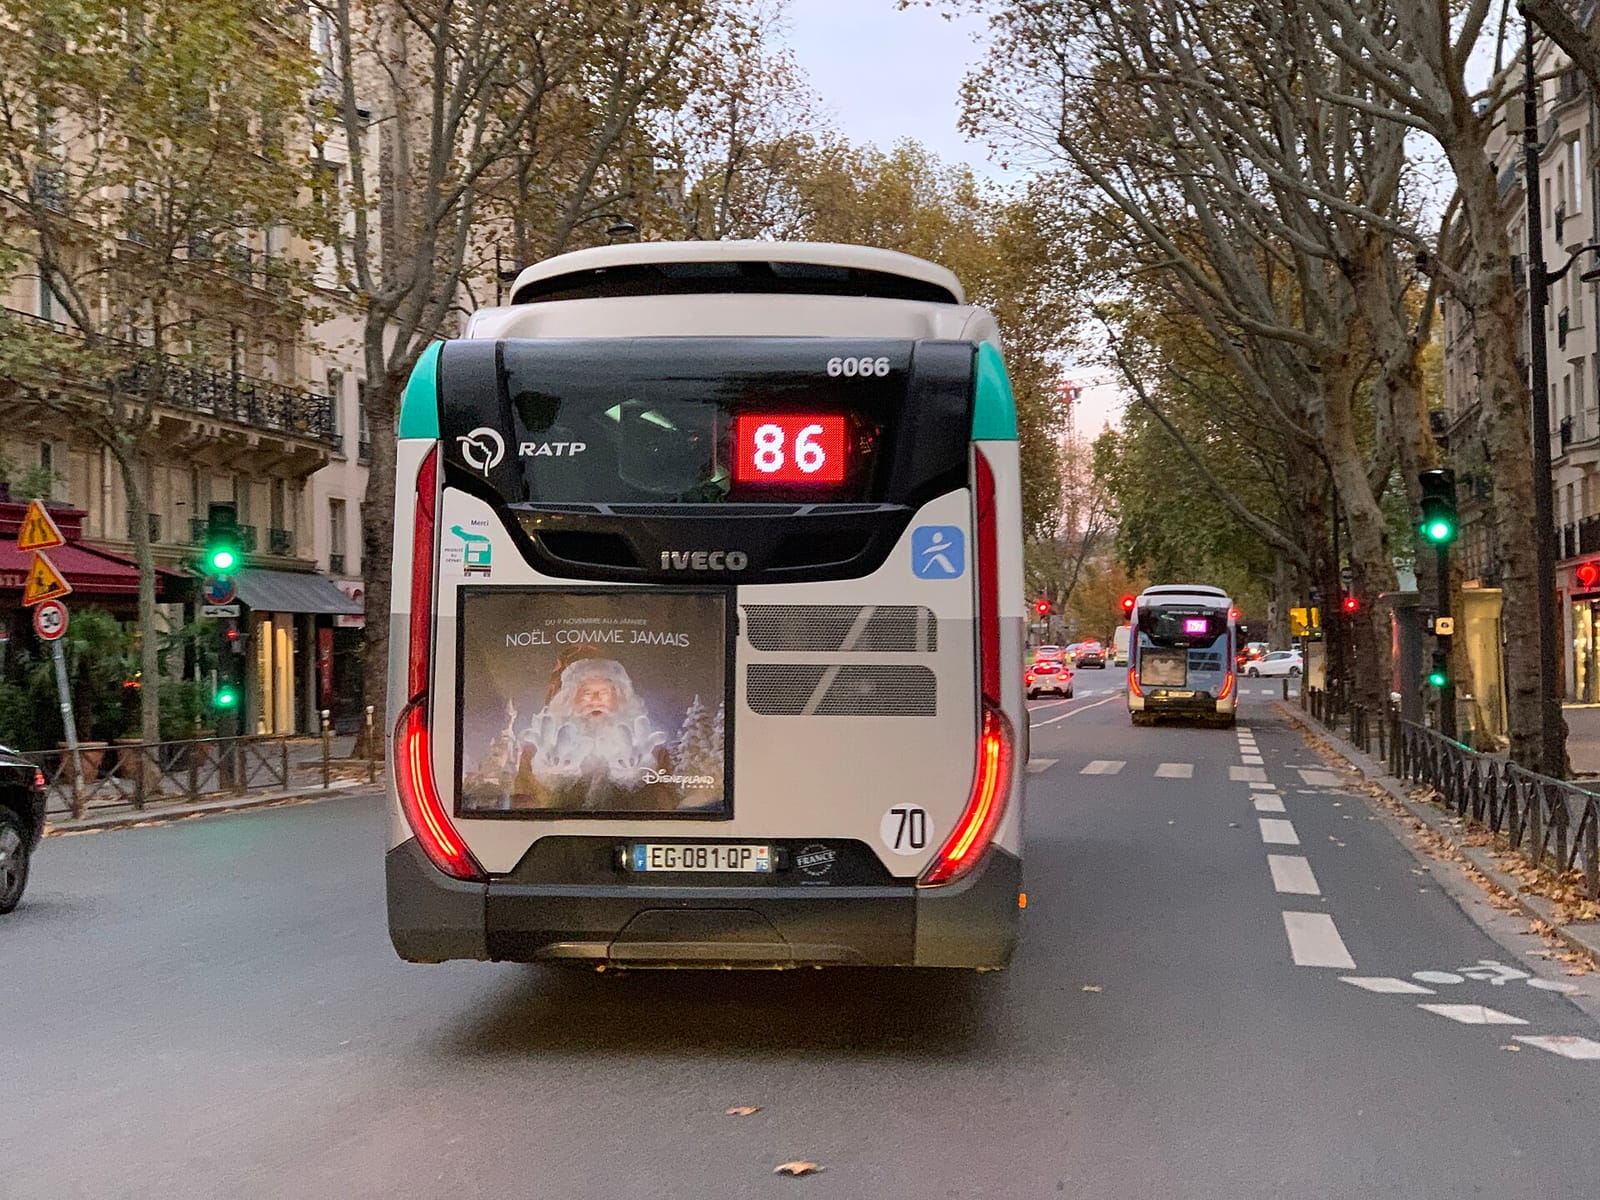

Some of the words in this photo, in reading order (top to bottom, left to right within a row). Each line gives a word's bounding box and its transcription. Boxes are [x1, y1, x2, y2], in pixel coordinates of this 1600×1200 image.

[827, 357, 890, 377] 6066
[518, 442, 587, 457] RATP
[754, 424, 826, 474] 86
[471, 519, 489, 527] Merci
[661, 551, 748, 571] IVECO
[42, 611, 60, 629] 30
[506, 629, 551, 647] NOËL
[555, 629, 625, 644] COMME
[630, 630, 690, 648] JAMAIS
[891, 808, 925, 849] 70
[797, 851, 834, 866] FRANCE
